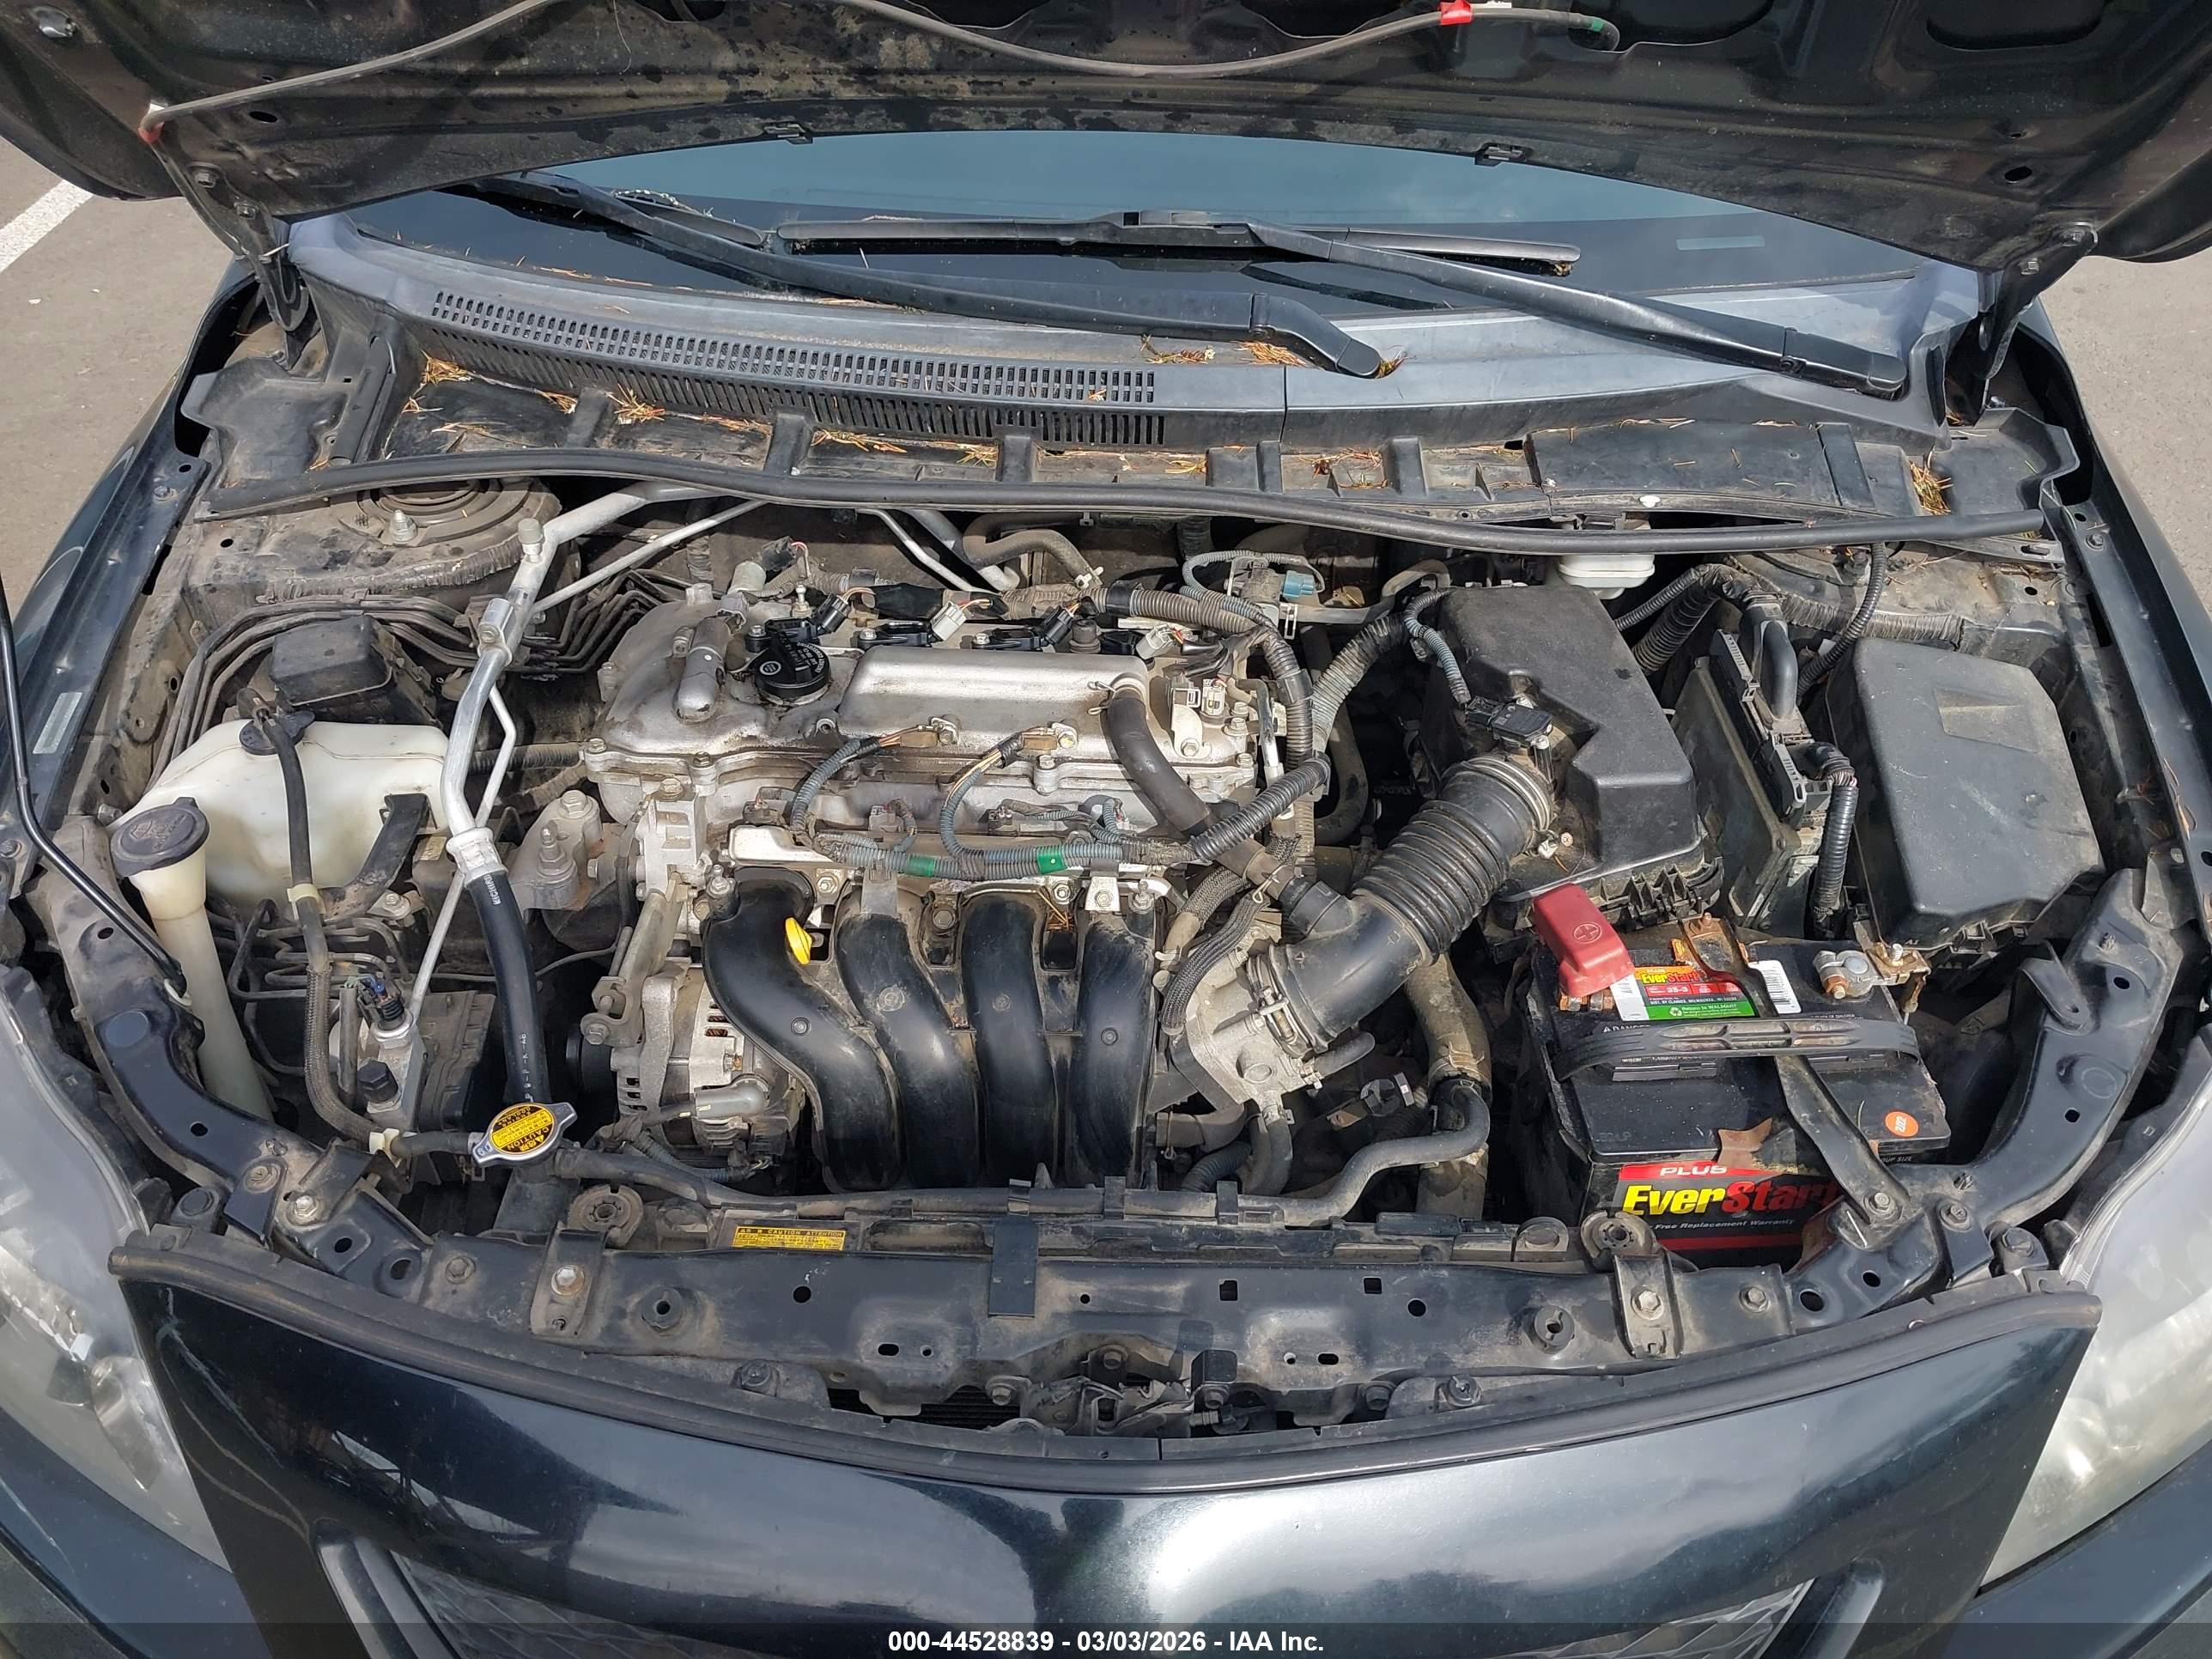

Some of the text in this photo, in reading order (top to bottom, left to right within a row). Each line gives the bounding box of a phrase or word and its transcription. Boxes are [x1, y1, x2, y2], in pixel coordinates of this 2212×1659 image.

[1641, 970, 1700, 985] EverStart
[507, 1127, 550, 1151] CAUTION
[1659, 1165, 1728, 1177] PLUS
[1621, 1179, 1838, 1216] EverStart
[1680, 1220, 1747, 1230] Replacement
[1750, 1218, 1795, 1226] Warranty
